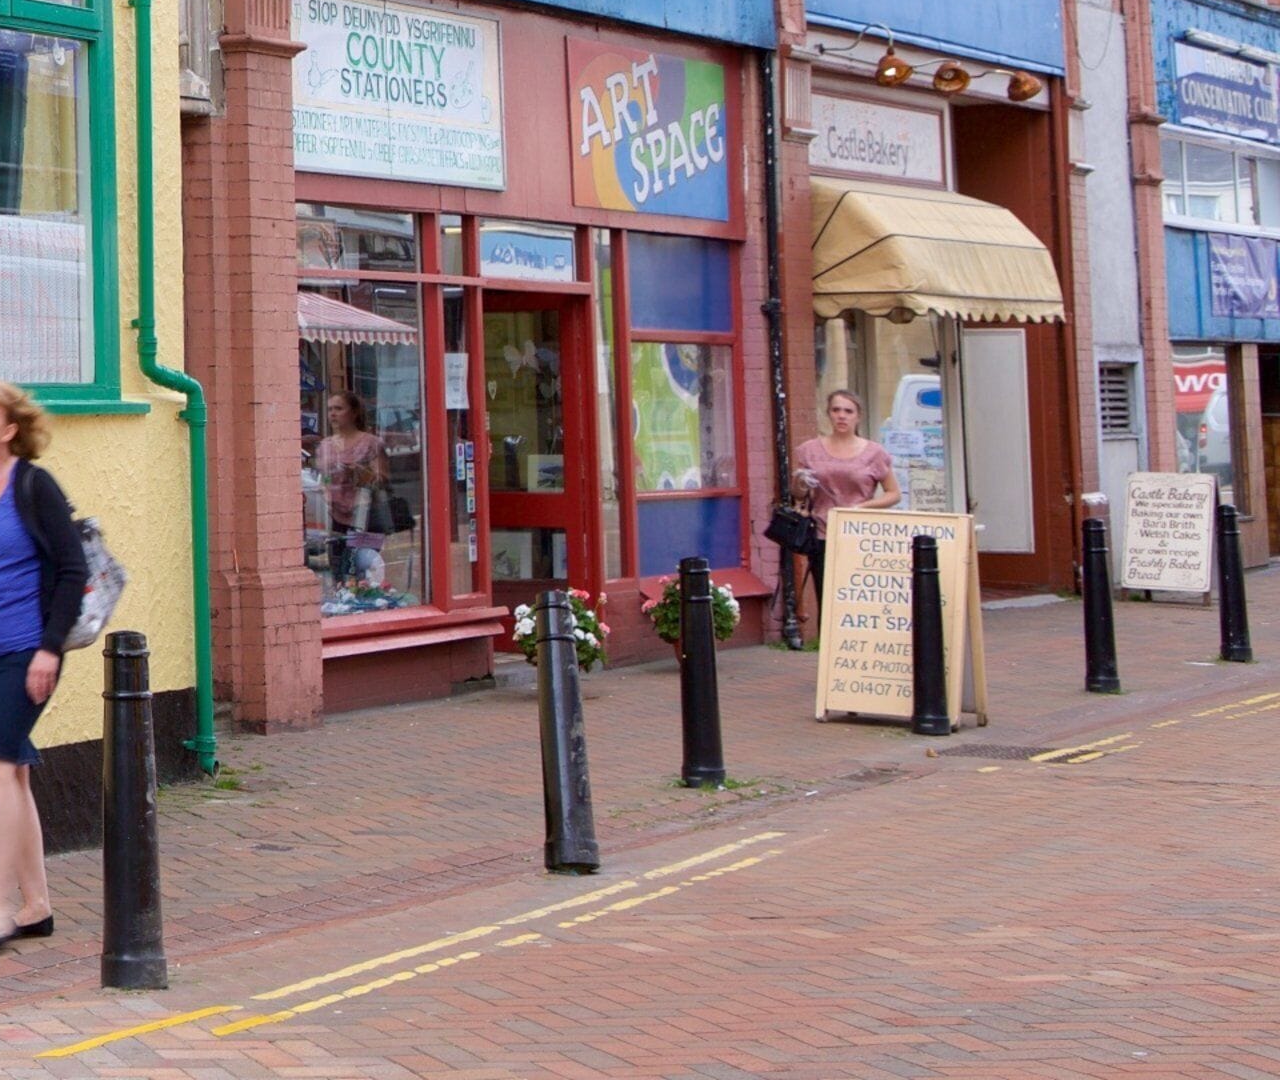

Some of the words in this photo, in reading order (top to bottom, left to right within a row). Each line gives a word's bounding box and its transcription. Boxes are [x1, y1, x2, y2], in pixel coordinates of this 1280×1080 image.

[308, 0, 338, 22] SIOP
[343, 5, 401, 36] DEUNYDD
[405, 16, 476, 49] YSGRIFENNU
[346, 32, 446, 78] COUNTY
[340, 68, 448, 108] STATIONERS
[580, 54, 659, 156] ART
[1181, 78, 1254, 119] CONSERVATIVE
[630, 103, 724, 203] SPACE
[1131, 487, 1165, 500] Castle
[1167, 488, 1208, 503] Bakery
[1131, 508, 1163, 520] Baking
[843, 520, 955, 540] INFORMATION
[1142, 520, 1166, 529] Bara
[1169, 520, 1195, 529] Brith
[1139, 530, 1170, 538] Welsh
[1172, 530, 1201, 540] Cakes
[1169, 549, 1199, 558] recipe
[850, 574, 914, 591] COUNT
[840, 614, 880, 630] ART
[839, 639, 868, 654] ART
[834, 657, 859, 670] FAX
[860, 661, 868, 670] &
[850, 680, 892, 696] 01407
